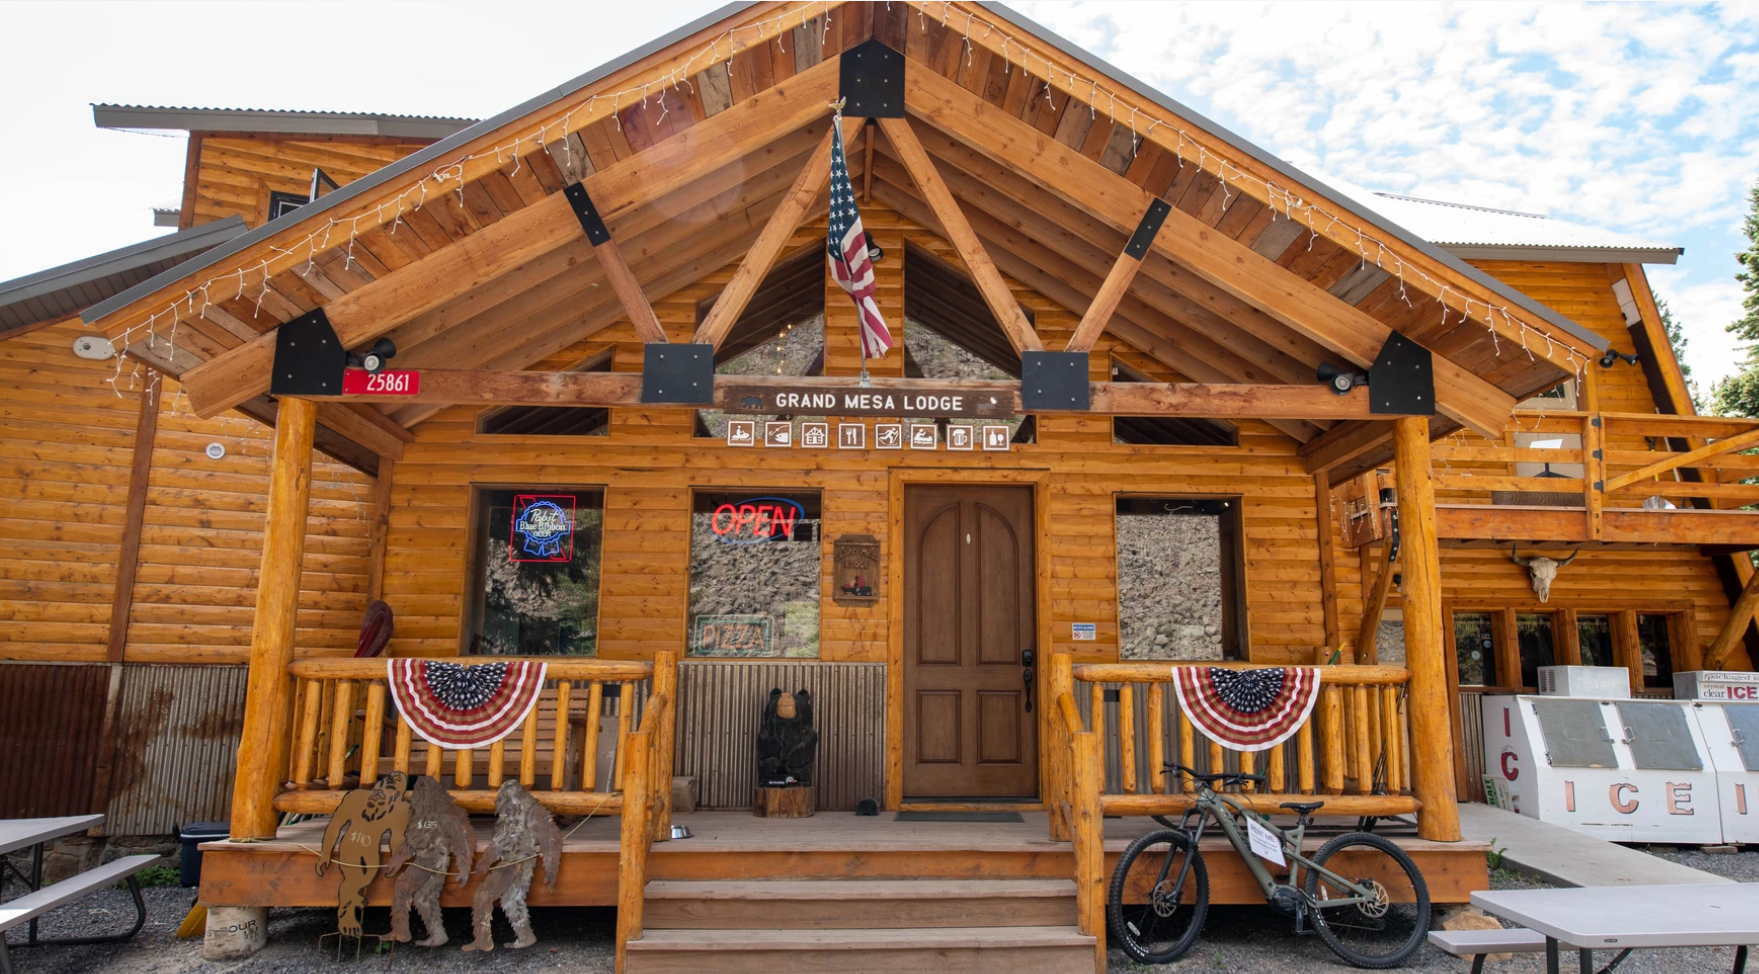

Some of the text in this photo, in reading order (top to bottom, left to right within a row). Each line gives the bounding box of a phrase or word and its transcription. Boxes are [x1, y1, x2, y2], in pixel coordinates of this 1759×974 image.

[366, 373, 410, 392] 25861
[775, 393, 963, 411] GRAND MESA LODGE
[530, 508, 559, 522] Pabst
[711, 503, 797, 537] OPEN
[519, 520, 566, 531] Blue Ribbon
[702, 623, 765, 650] PIZZA
[1704, 674, 1750, 682] packaged
[1703, 685, 1758, 699] clear ICE
[1564, 779, 1695, 816] ICE
[350, 831, 372, 847] $110
